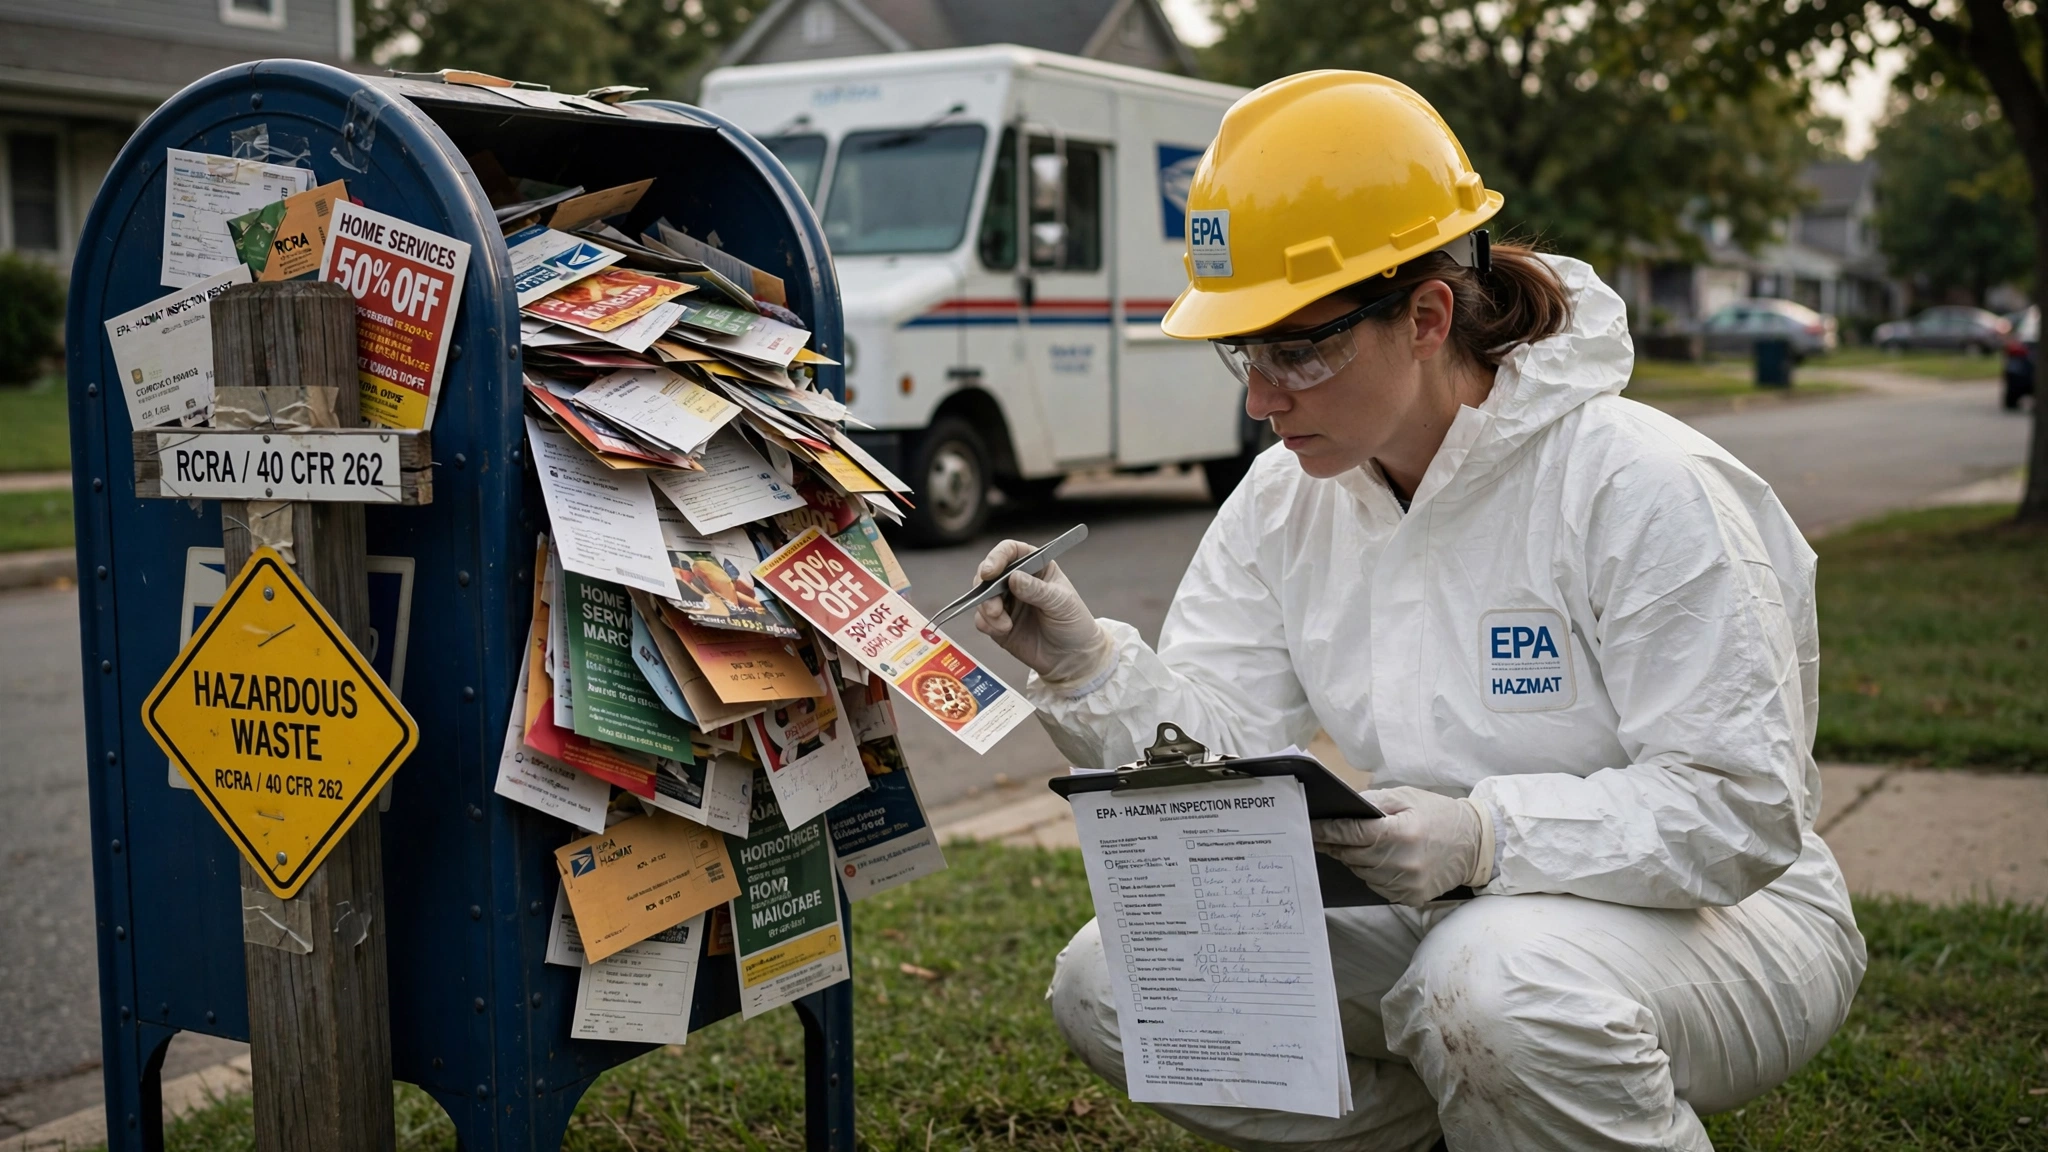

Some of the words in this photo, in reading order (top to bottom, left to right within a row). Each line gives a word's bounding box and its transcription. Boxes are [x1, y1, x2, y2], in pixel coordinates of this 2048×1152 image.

[274, 232, 310, 255] RCRA
[339, 212, 386, 245] HOME
[388, 229, 457, 270] SERVICES
[1191, 217, 1226, 246] EPA
[334, 246, 392, 300] 50%
[391, 267, 444, 322] OFF
[176, 450, 236, 483] RCRA
[242, 450, 250, 483] /
[257, 451, 283, 484] 40
[291, 452, 335, 485] CFR
[342, 452, 384, 486] 262
[778, 549, 844, 601] 50%
[580, 583, 627, 612] HOME
[817, 571, 870, 619] OFF
[870, 603, 893, 625] OFF
[1491, 626, 1559, 659] EPA
[193, 670, 358, 719] HAZARDOUS
[1492, 677, 1562, 695] HAZMAT
[231, 718, 323, 762] WASTE
[214, 768, 253, 792] RCRA
[256, 772, 262, 793] /
[265, 773, 282, 794] 40
[285, 775, 313, 797] CFR
[317, 778, 343, 801] 262
[1096, 808, 1118, 819] EPA
[1125, 803, 1167, 817] HAZMAT
[1170, 798, 1232, 814] INSPECTION
[1234, 796, 1276, 810] REPORT
